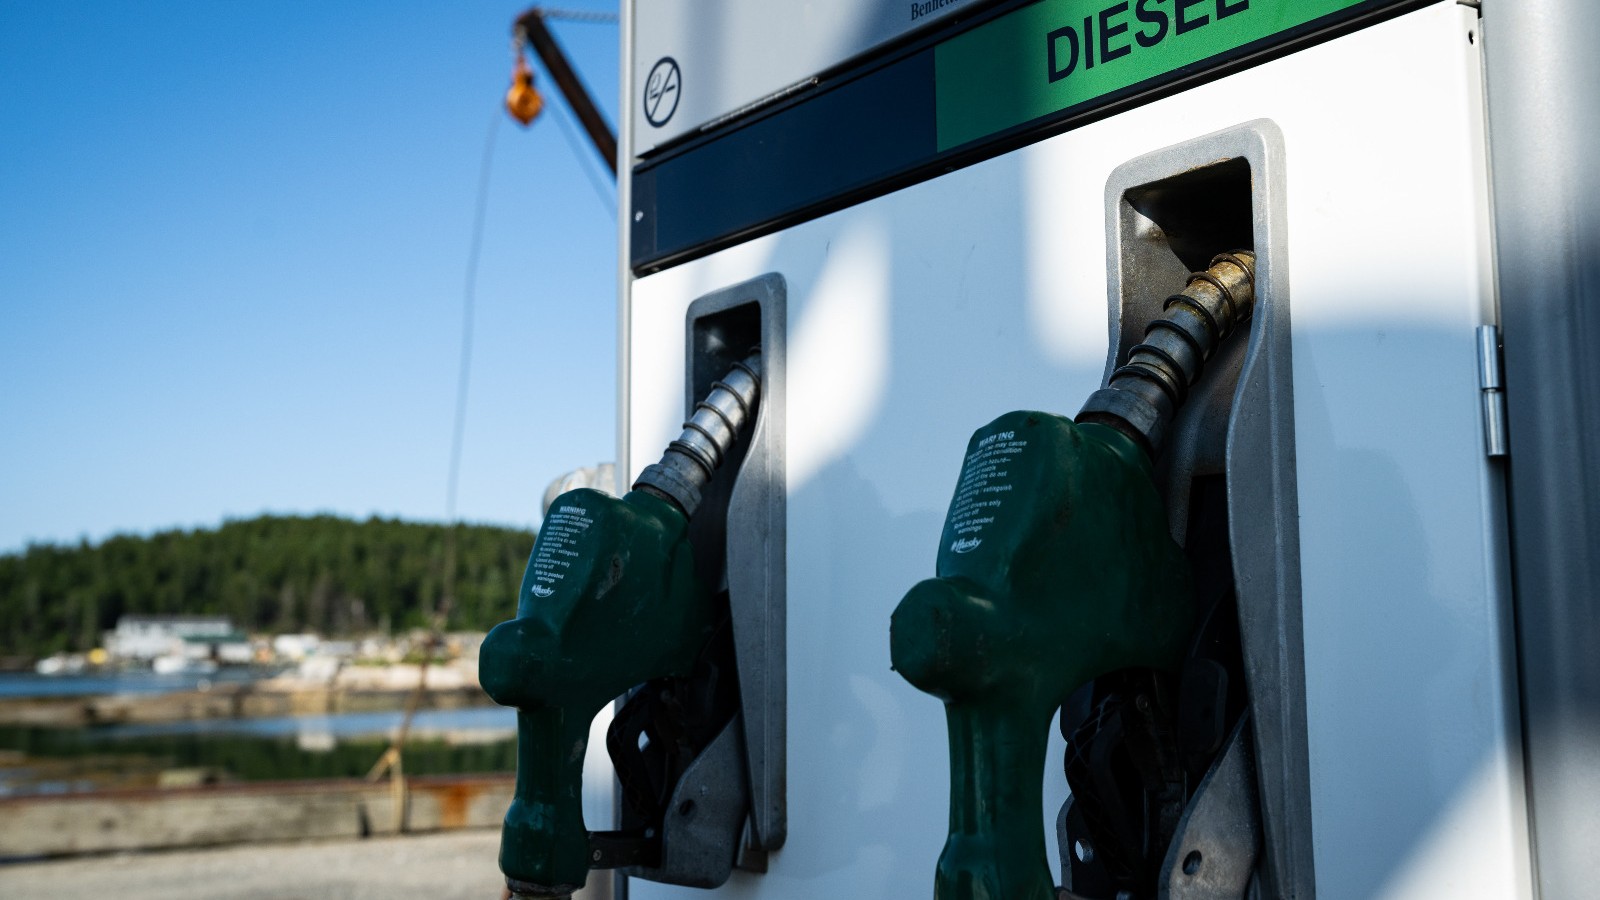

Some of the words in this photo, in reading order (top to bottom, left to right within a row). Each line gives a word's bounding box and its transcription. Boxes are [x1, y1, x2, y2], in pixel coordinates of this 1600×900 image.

[911, 0, 957, 20] Benne
[993, 448, 1022, 456] condition
[983, 484, 1012, 493] extinguish
[989, 499, 1001, 507] only
[559, 506, 586, 515] WARNING
[972, 516, 994, 525] posted
[958, 525, 982, 534] warnings
[955, 537, 981, 552] Husky
